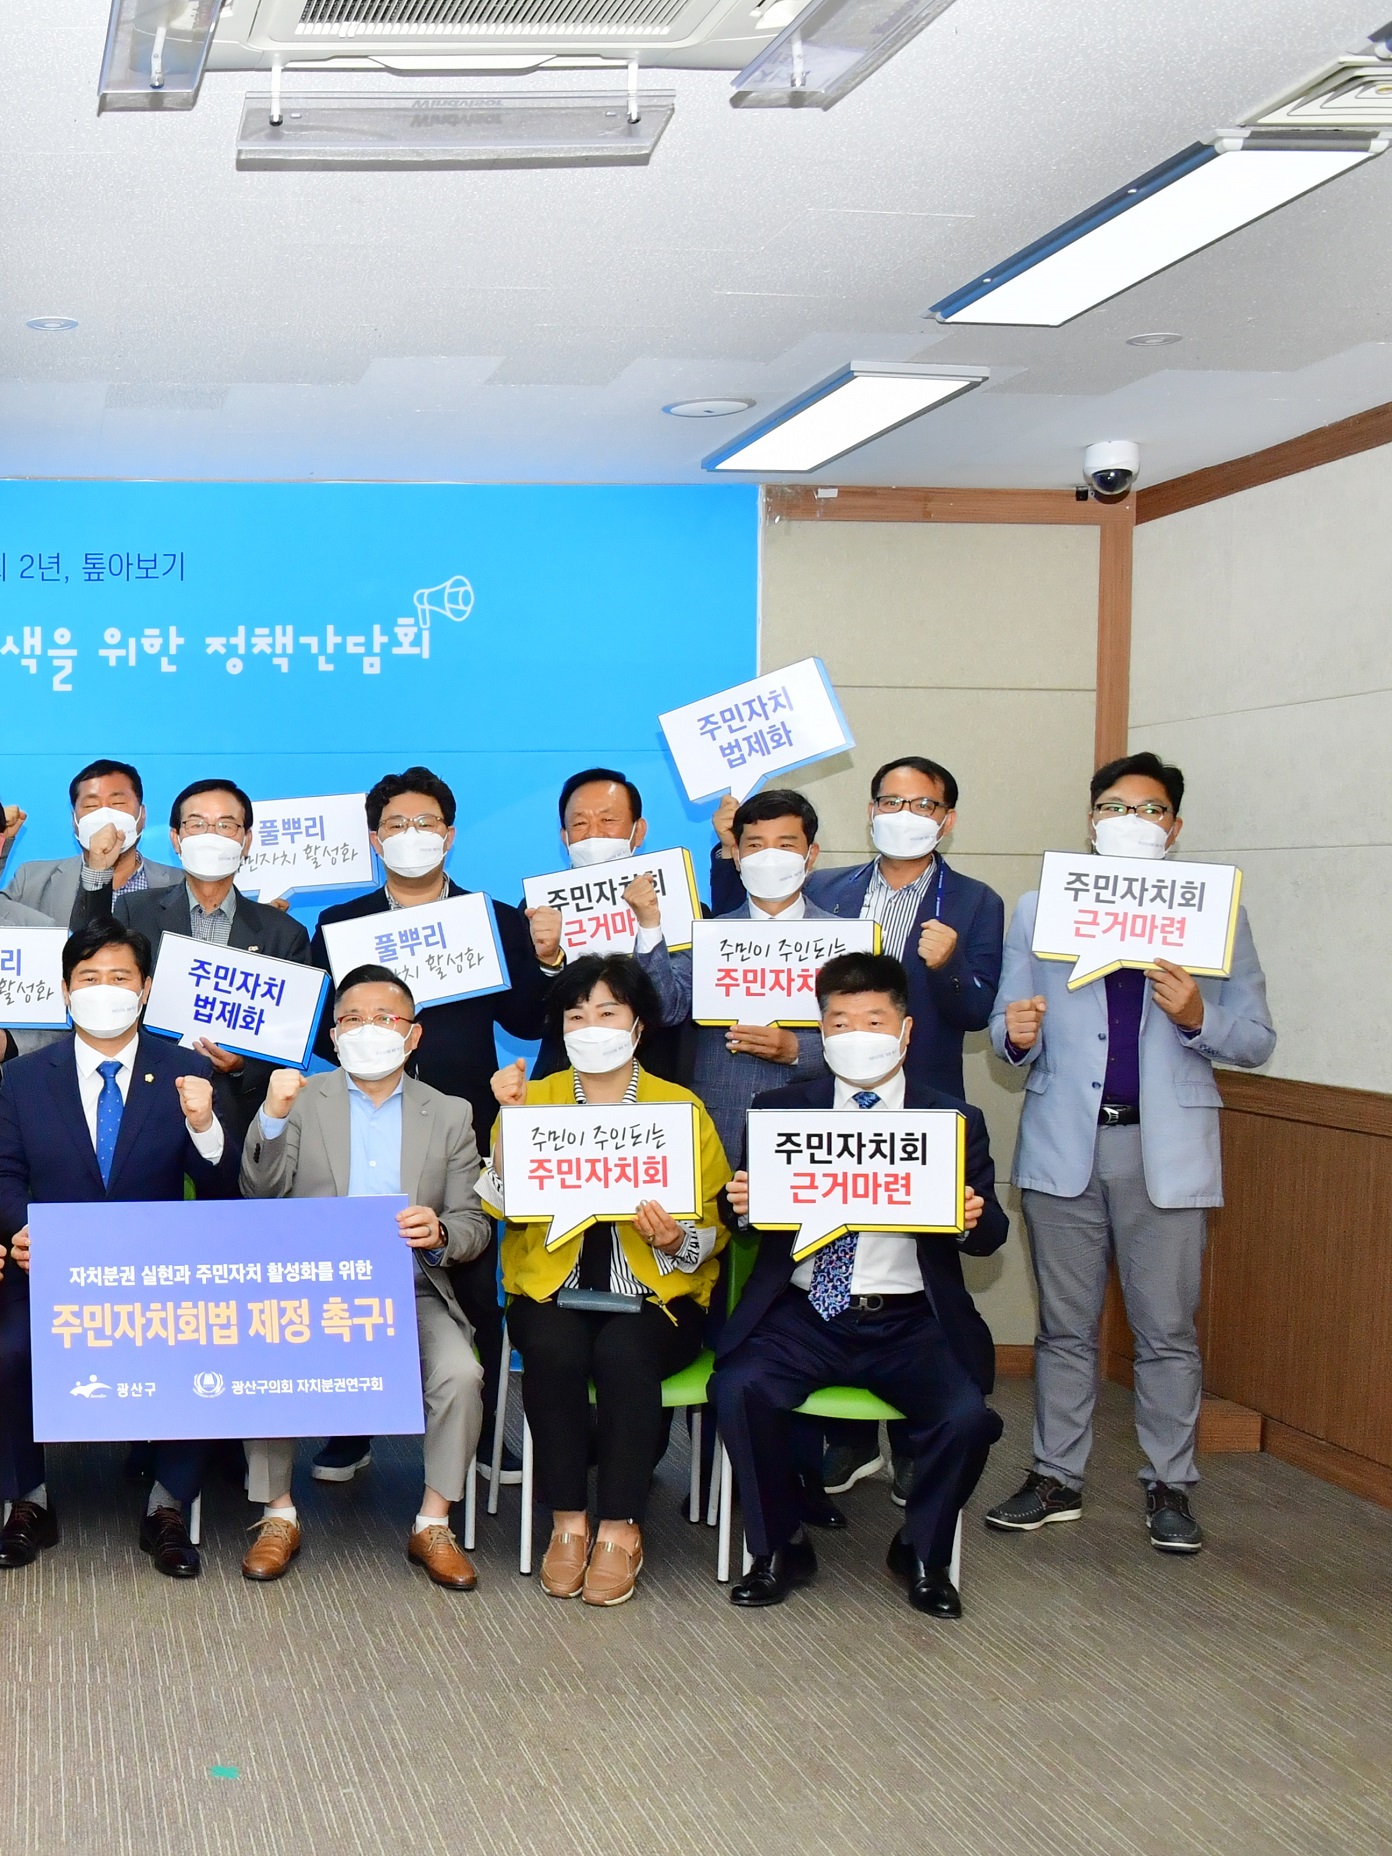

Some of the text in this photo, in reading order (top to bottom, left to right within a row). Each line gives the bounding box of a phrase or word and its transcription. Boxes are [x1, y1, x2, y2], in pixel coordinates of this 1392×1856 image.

[19, 552, 70, 584] 2년,
[82, 551, 185, 583] 톺아보기
[98, 626, 184, 672] 위한
[206, 617, 429, 674] 정책간담회
[697, 685, 794, 741] 주민자치
[719, 721, 793, 769] 법제화
[258, 815, 325, 846] 풀뿌리
[238, 842, 358, 873] 민자치 활성화
[1063, 872, 1206, 912] 주민자치회
[374, 921, 447, 963] 풀뿌리
[564, 908, 636, 947] 근거마
[1073, 909, 1187, 947] 근거마련
[425, 947, 485, 980] 활성화
[720, 938, 846, 962] 주민이 주인되는
[188, 959, 286, 1007] 주민자치
[715, 968, 820, 997] 주민자치
[193, 994, 265, 1036] 법제화
[531, 1123, 666, 1152] 주민이 주인되는
[774, 1131, 927, 1166] 주민자치회
[528, 1155, 668, 1191] 주민자치회
[790, 1171, 911, 1205] 근거마련
[69, 1259, 373, 1287] 자치분권 실현과 주민자치 활성화를 위한
[51, 1296, 396, 1348] 주민자치회법 제정 촉구!
[116, 1382, 157, 1398] 광산구
[231, 1379, 293, 1396] 광산구의회
[297, 1376, 384, 1393] 자치분권연구회
